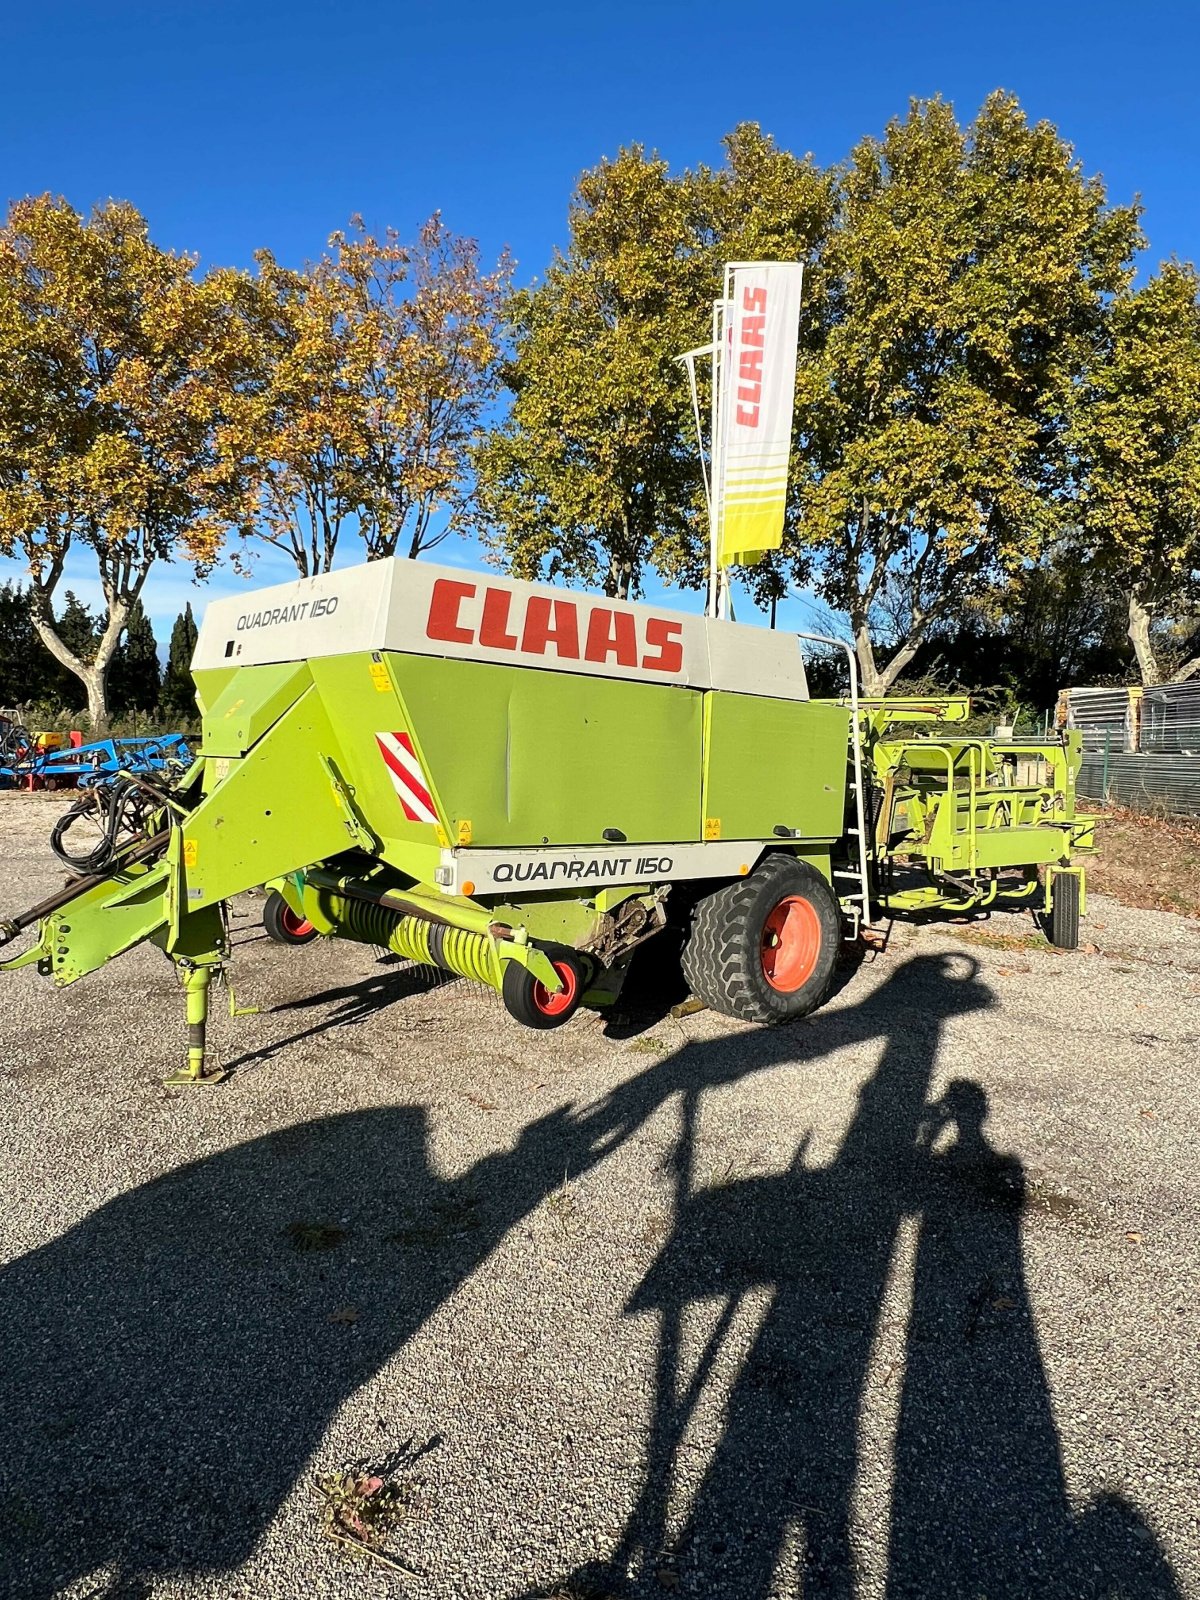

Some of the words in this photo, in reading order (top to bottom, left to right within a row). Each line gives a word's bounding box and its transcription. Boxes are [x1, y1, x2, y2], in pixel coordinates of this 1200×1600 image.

[736, 286, 768, 428] CLAAS
[236, 602, 309, 631] QUADRANT
[309, 596, 339, 618] 1150
[426, 578, 683, 673] CLAAS
[493, 858, 632, 883] QUADRANT
[635, 857, 674, 875] 1150
